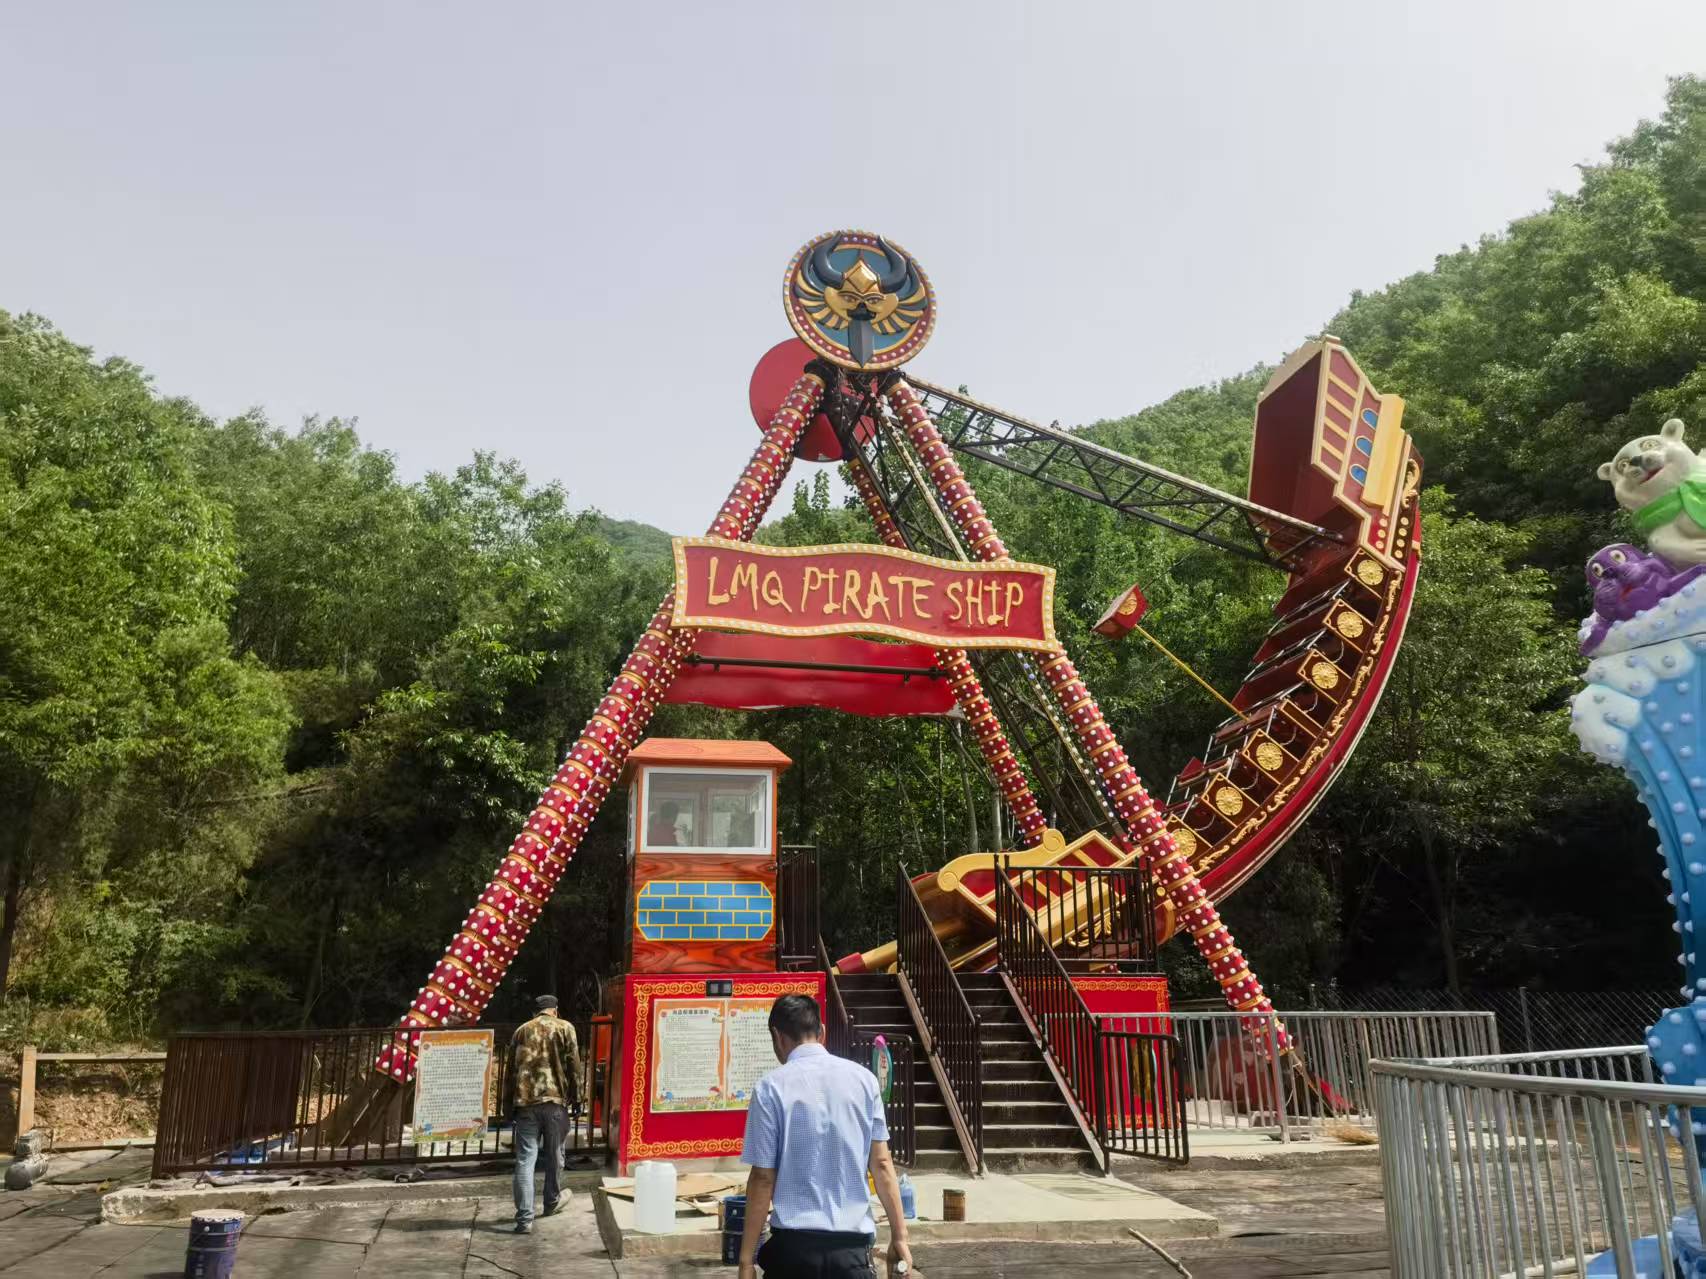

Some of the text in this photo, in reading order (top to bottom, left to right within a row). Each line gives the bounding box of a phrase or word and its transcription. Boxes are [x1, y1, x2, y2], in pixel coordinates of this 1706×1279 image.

[708, 556, 1024, 628] LMQ PIRATE SHIP
